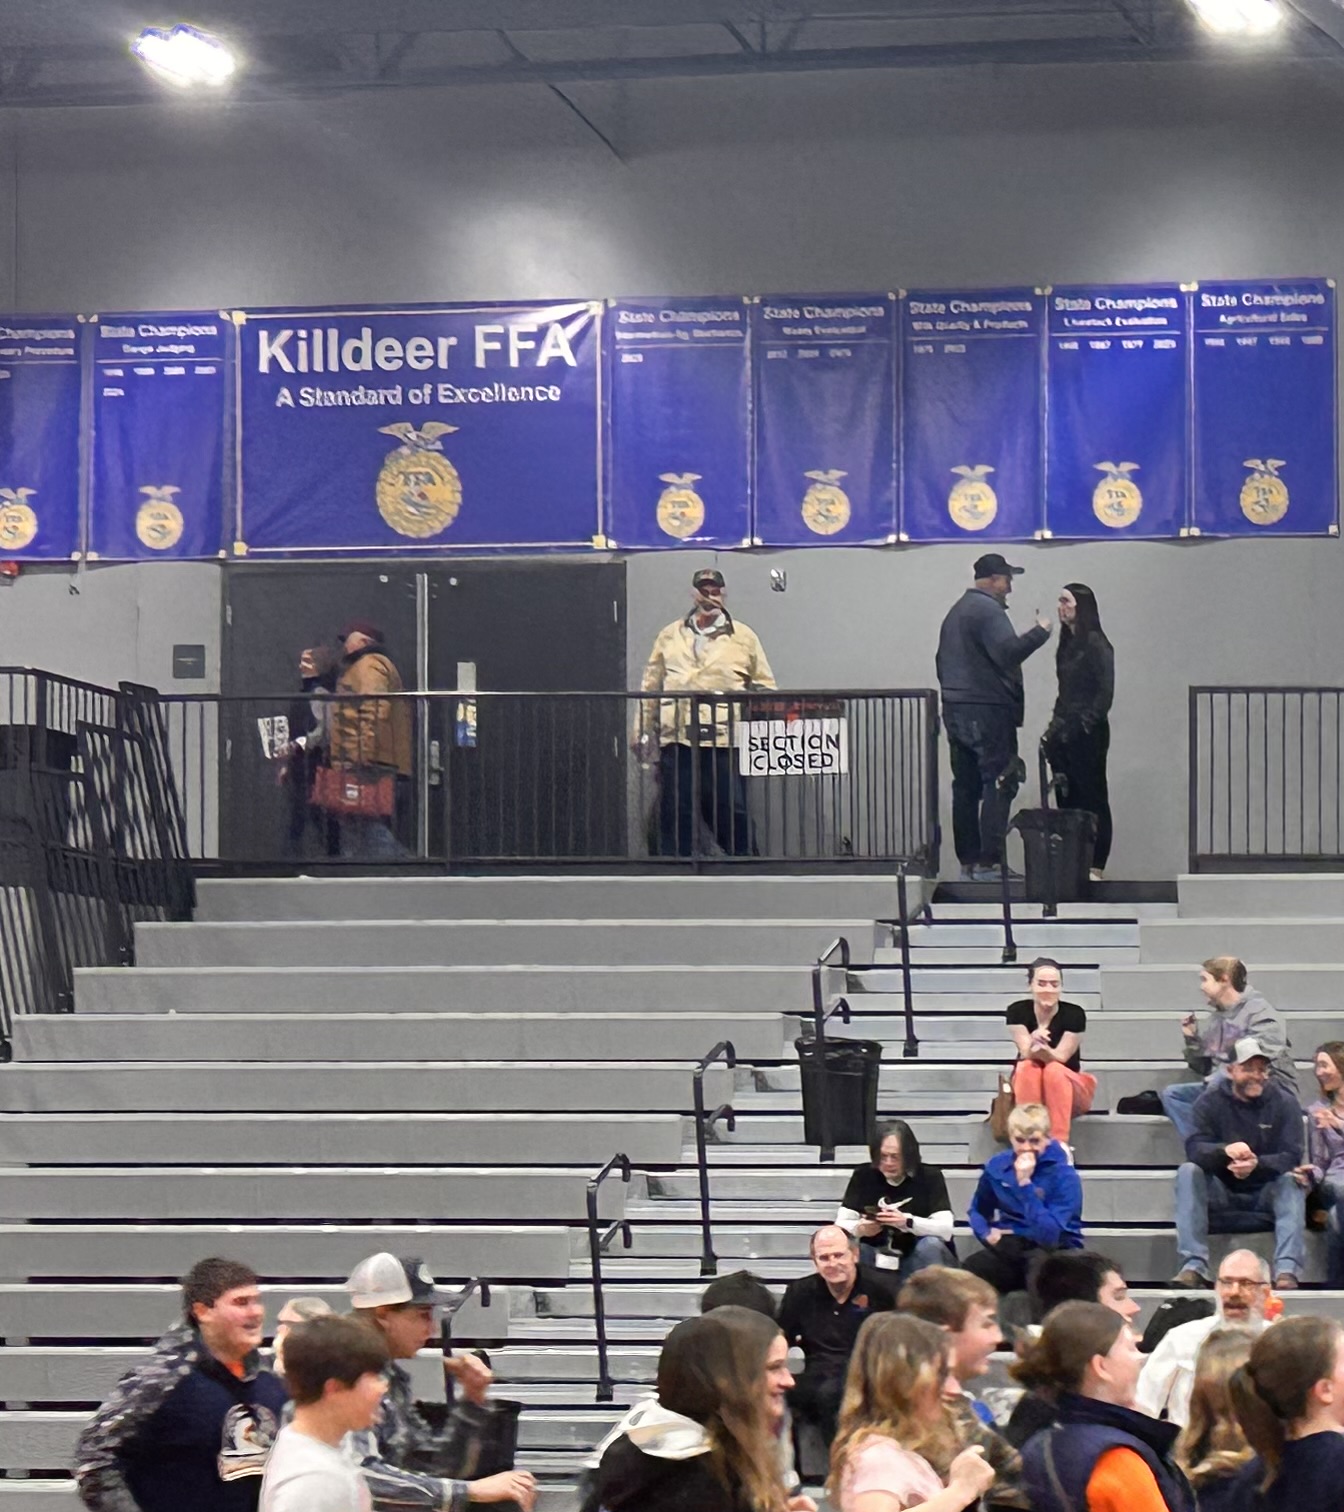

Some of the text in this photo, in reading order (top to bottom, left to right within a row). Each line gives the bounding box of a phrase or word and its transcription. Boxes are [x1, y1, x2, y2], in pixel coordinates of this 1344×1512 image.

[909, 300, 1033, 315] State Champions
[1055, 297, 1178, 312] State Champions
[1201, 293, 1325, 307] State Champions
[763, 306, 885, 320] State Champions
[258, 324, 578, 373] Killdeer FFA
[275, 382, 562, 408] A Standard of Excellence
[749, 734, 840, 752] SECTION
[753, 752, 834, 771] CLOSED
